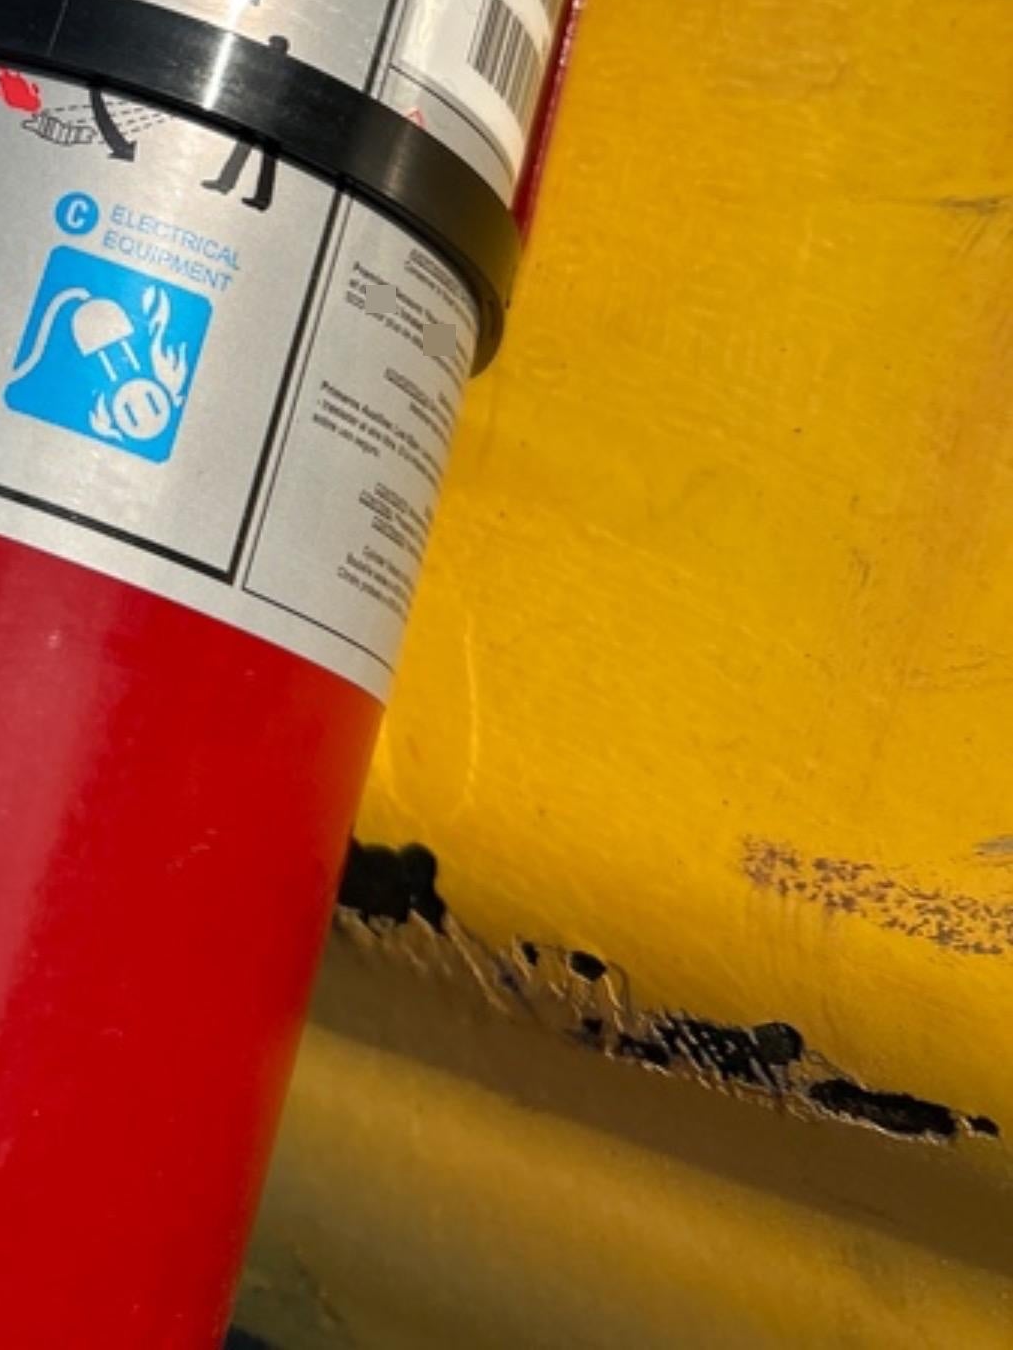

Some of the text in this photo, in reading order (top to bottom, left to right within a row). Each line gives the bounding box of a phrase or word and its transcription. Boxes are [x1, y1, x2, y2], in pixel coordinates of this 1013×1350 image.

[66, 198, 240, 270] C ELECTRICAL
[102, 230, 233, 292] EQUIPMENT
